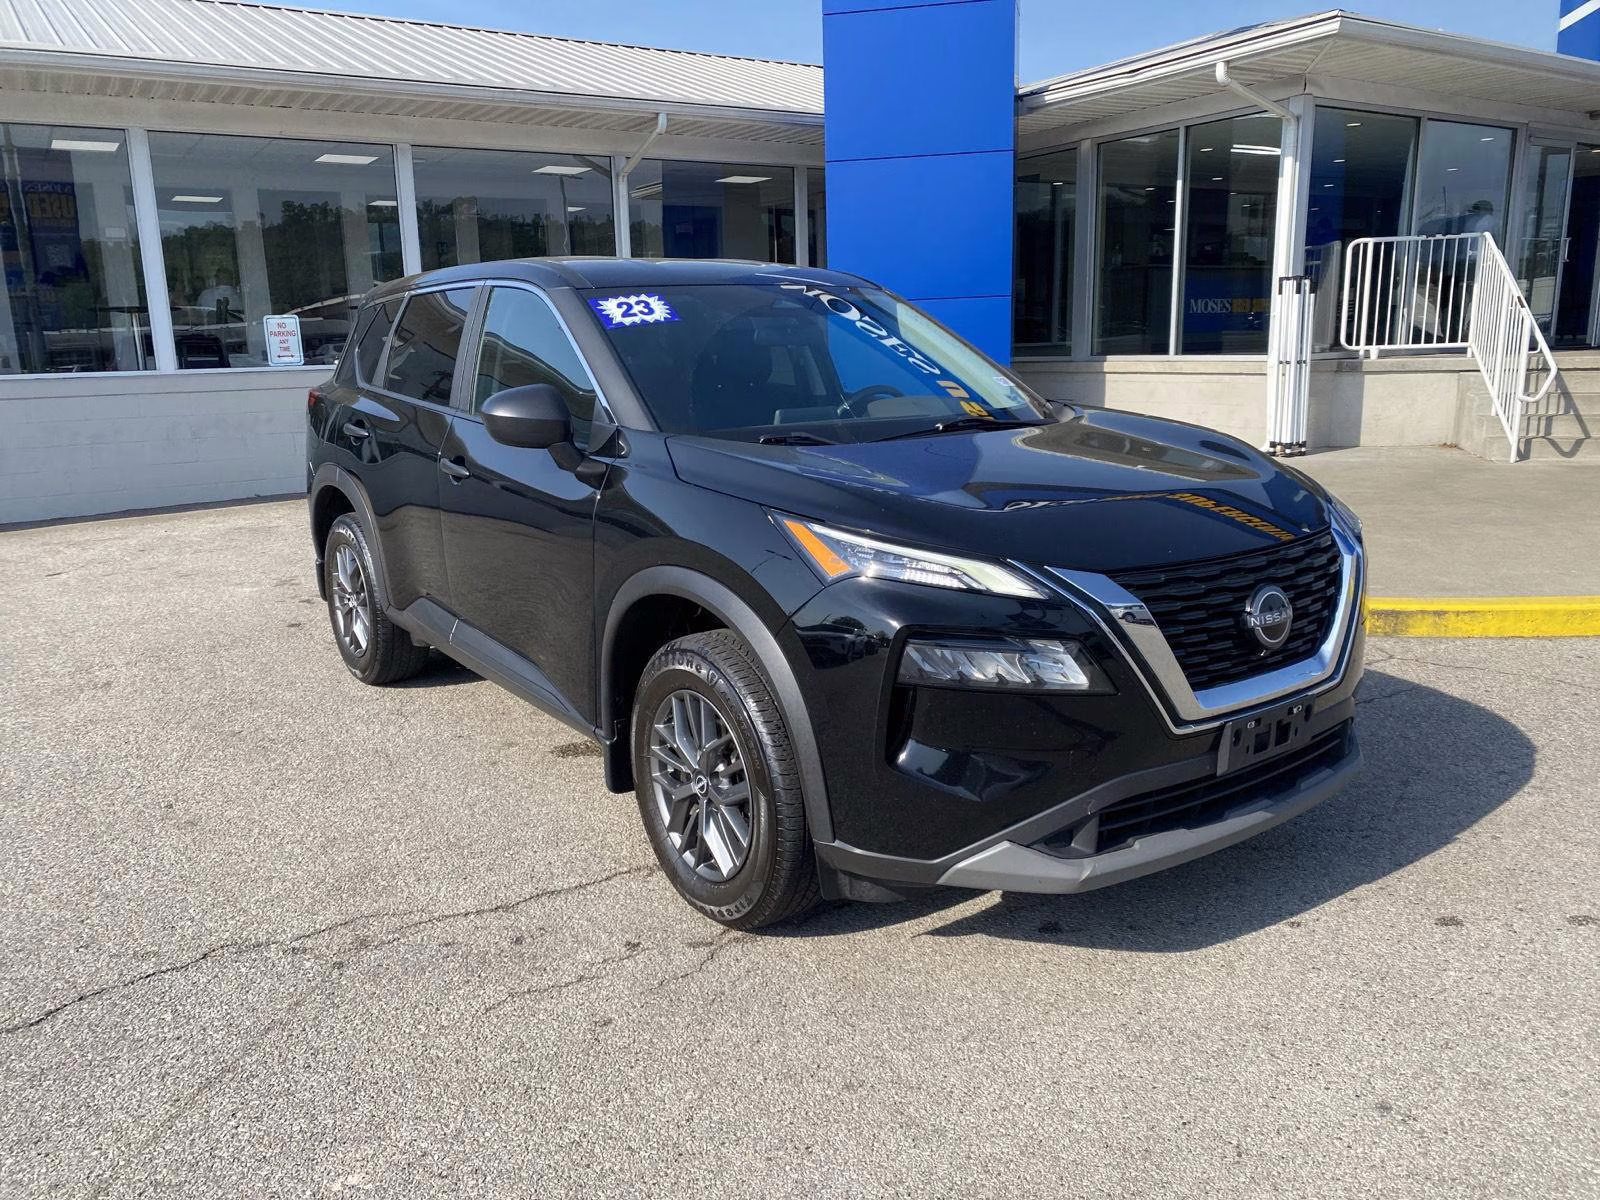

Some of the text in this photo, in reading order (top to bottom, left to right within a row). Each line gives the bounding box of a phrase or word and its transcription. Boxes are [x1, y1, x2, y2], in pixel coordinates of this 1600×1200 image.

[616, 300, 655, 318] 23
[1189, 298, 1232, 314] MOSES
[1250, 607, 1292, 627] NISSAN
